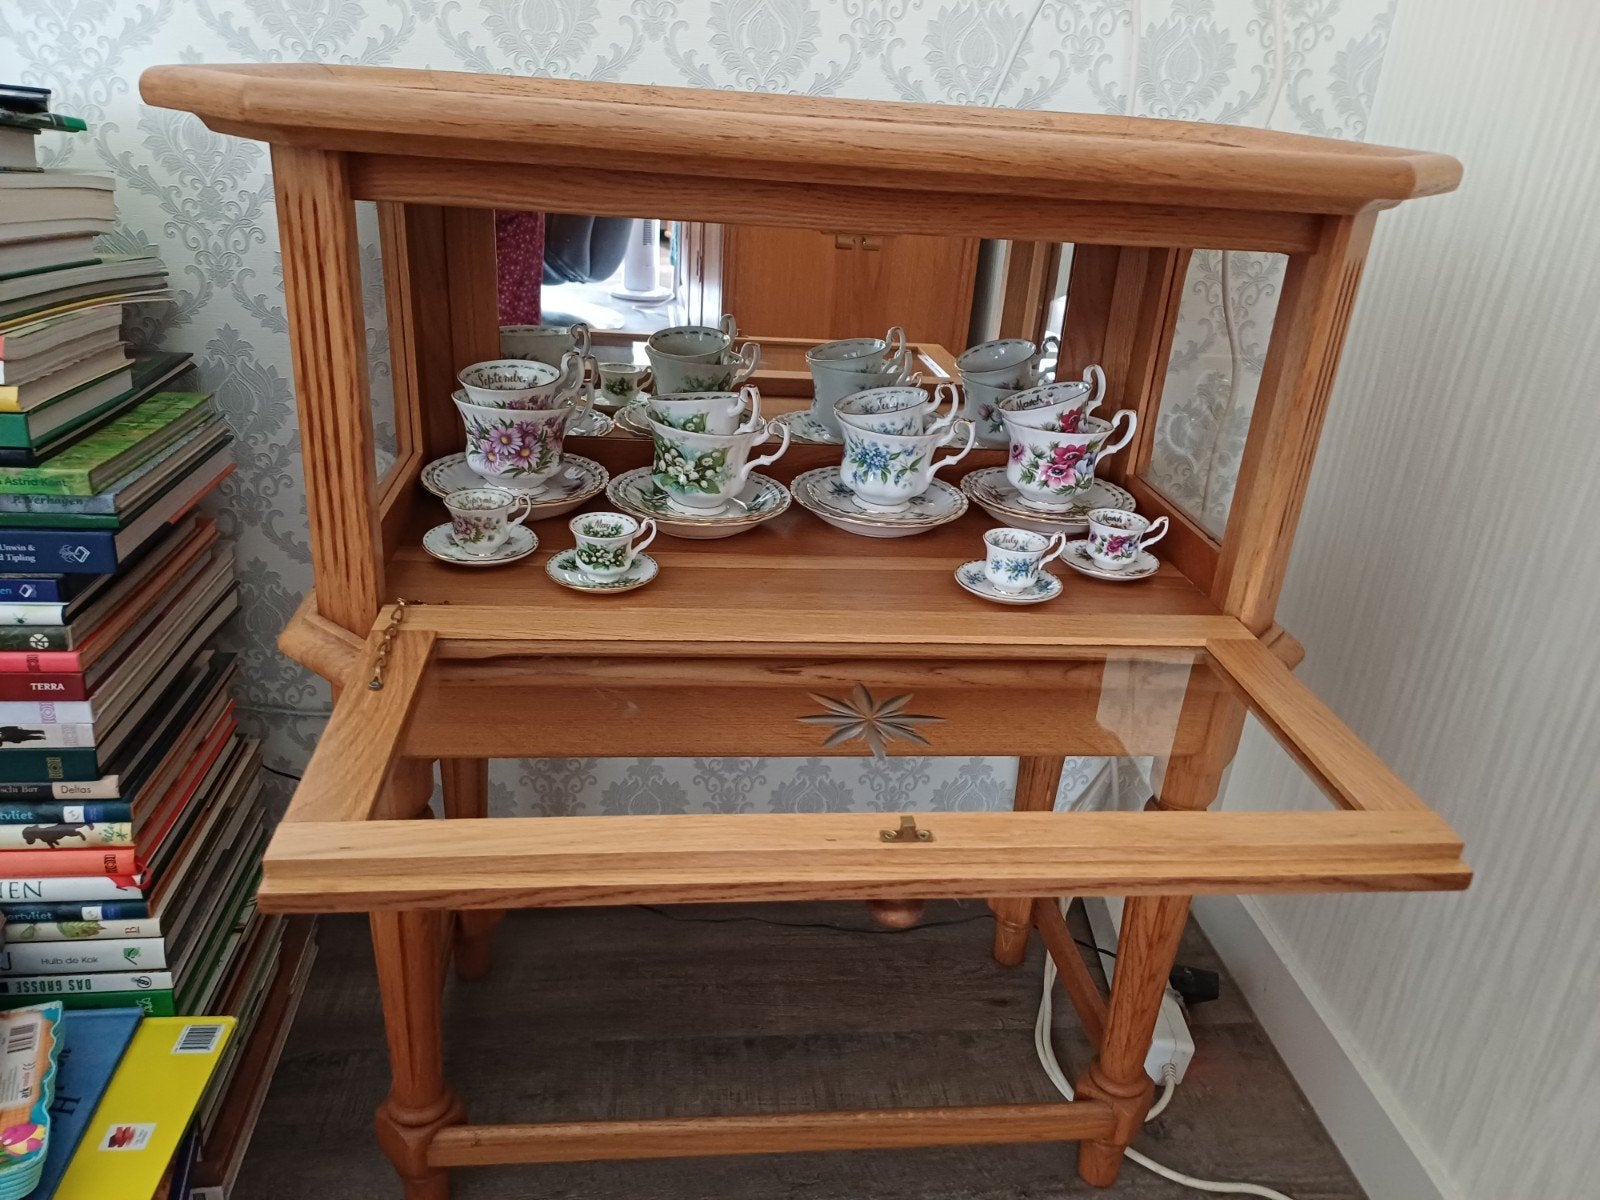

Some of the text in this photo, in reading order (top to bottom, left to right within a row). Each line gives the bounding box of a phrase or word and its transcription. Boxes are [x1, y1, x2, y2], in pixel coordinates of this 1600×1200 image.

[30, 682, 65, 691] TERRA
[60, 785, 92, 794] Deltas
[65, 955, 79, 964] de
[81, 955, 98, 964] Kok
[16, 979, 62, 993] GROSSE
[68, 978, 92, 990] DAS
